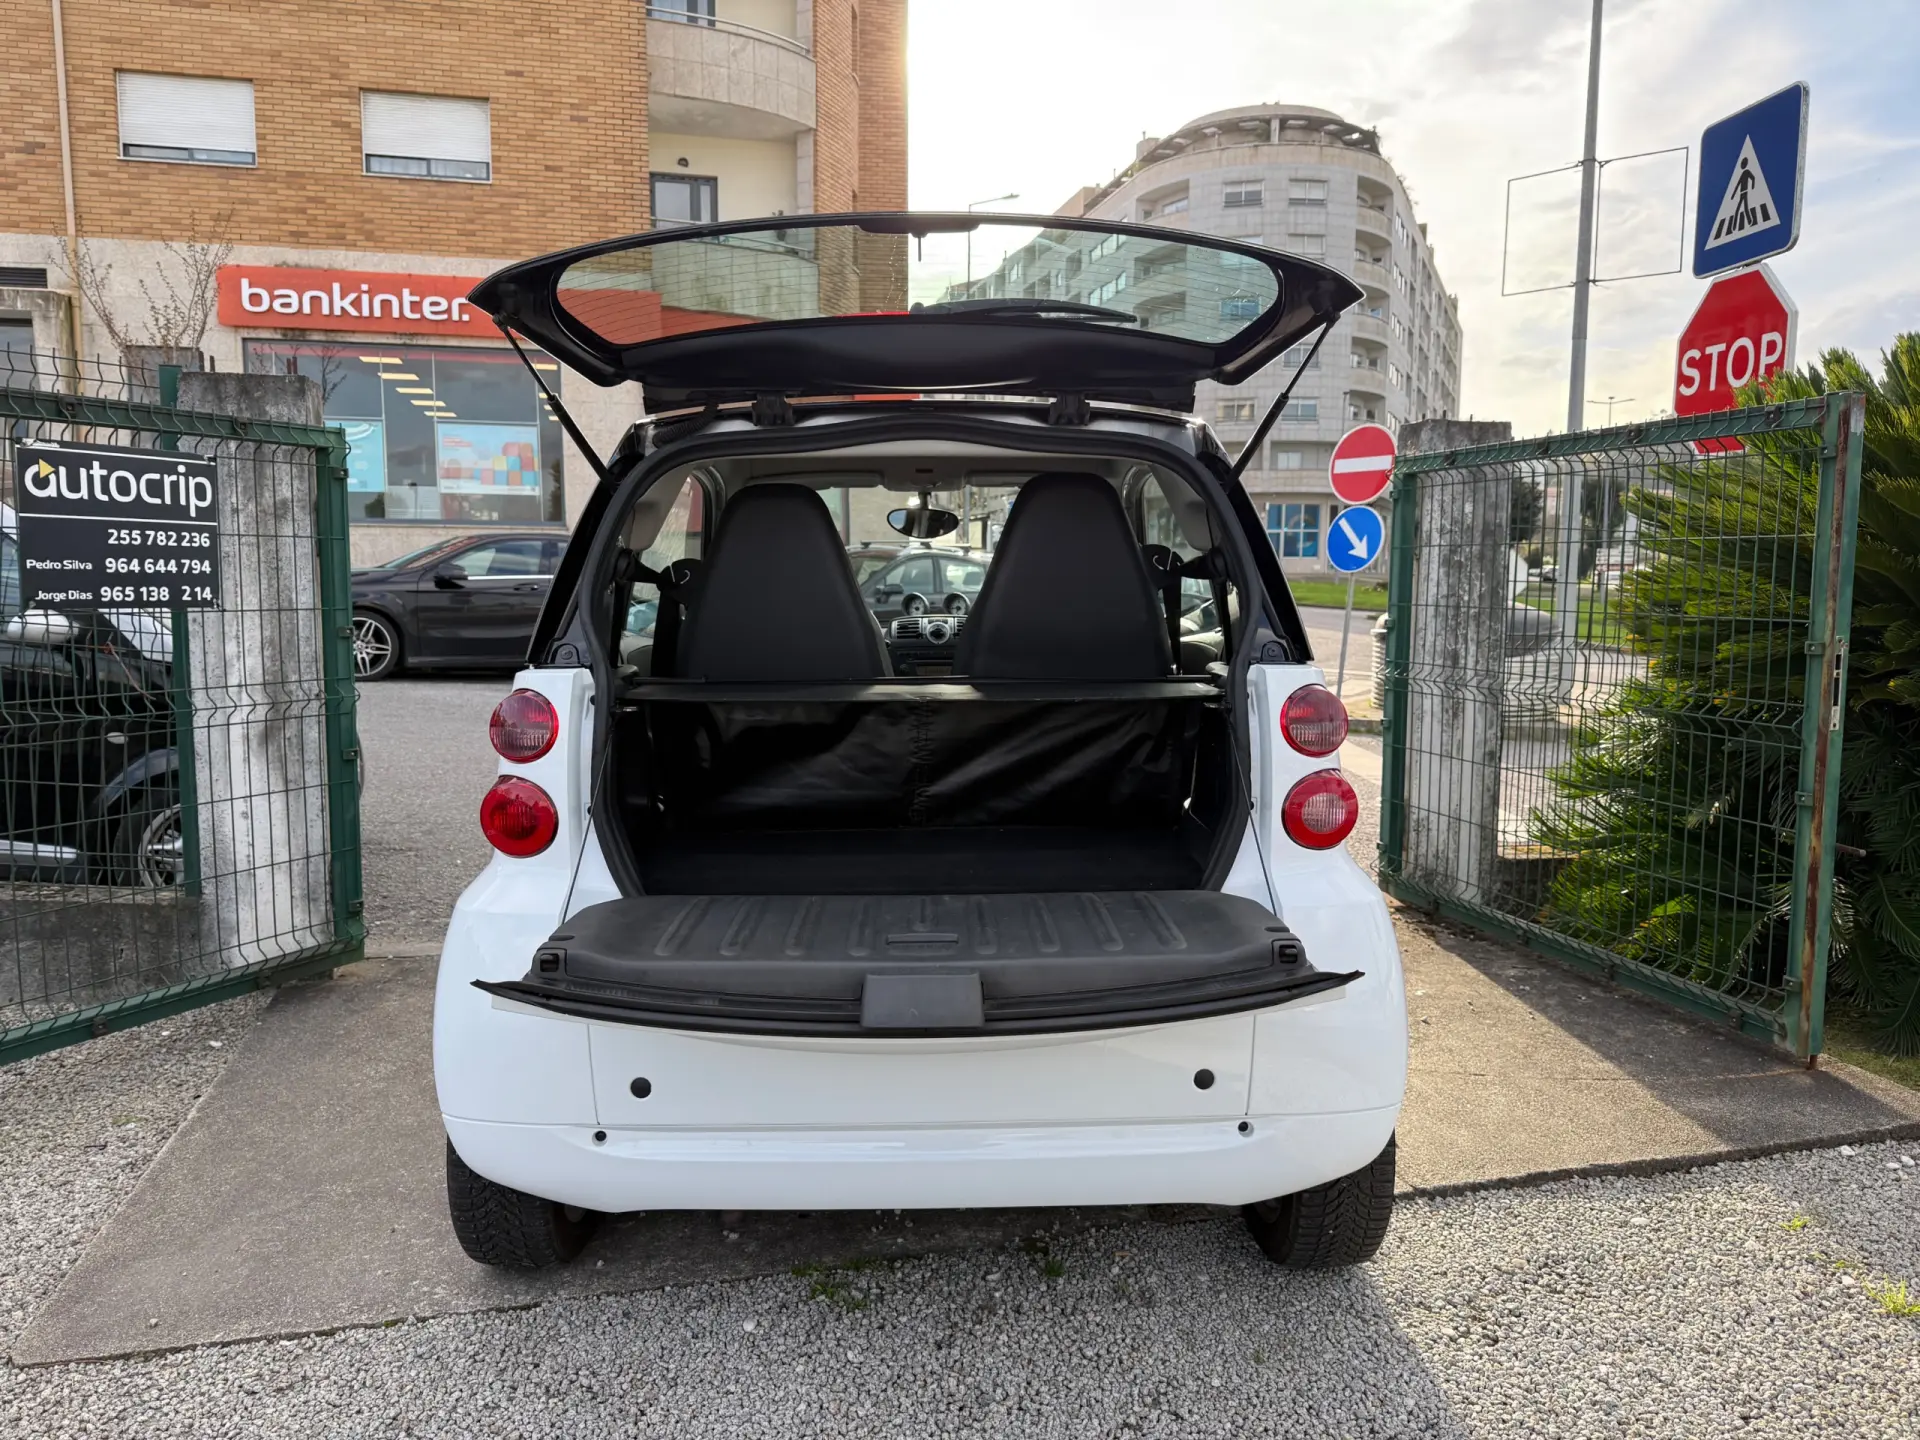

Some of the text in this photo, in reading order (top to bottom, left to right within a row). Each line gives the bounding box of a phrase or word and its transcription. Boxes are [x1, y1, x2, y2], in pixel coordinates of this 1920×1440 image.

[1679, 331, 1783, 396] STOP
[24, 458, 212, 517] autocrip
[107, 529, 211, 547] 255 782 236
[26, 558, 211, 574] Pedro Silva 964 644 794
[35, 590, 67, 602] Jorge
[68, 590, 93, 600] Dias
[100, 586, 135, 601] 965
[139, 586, 170, 601] 138
